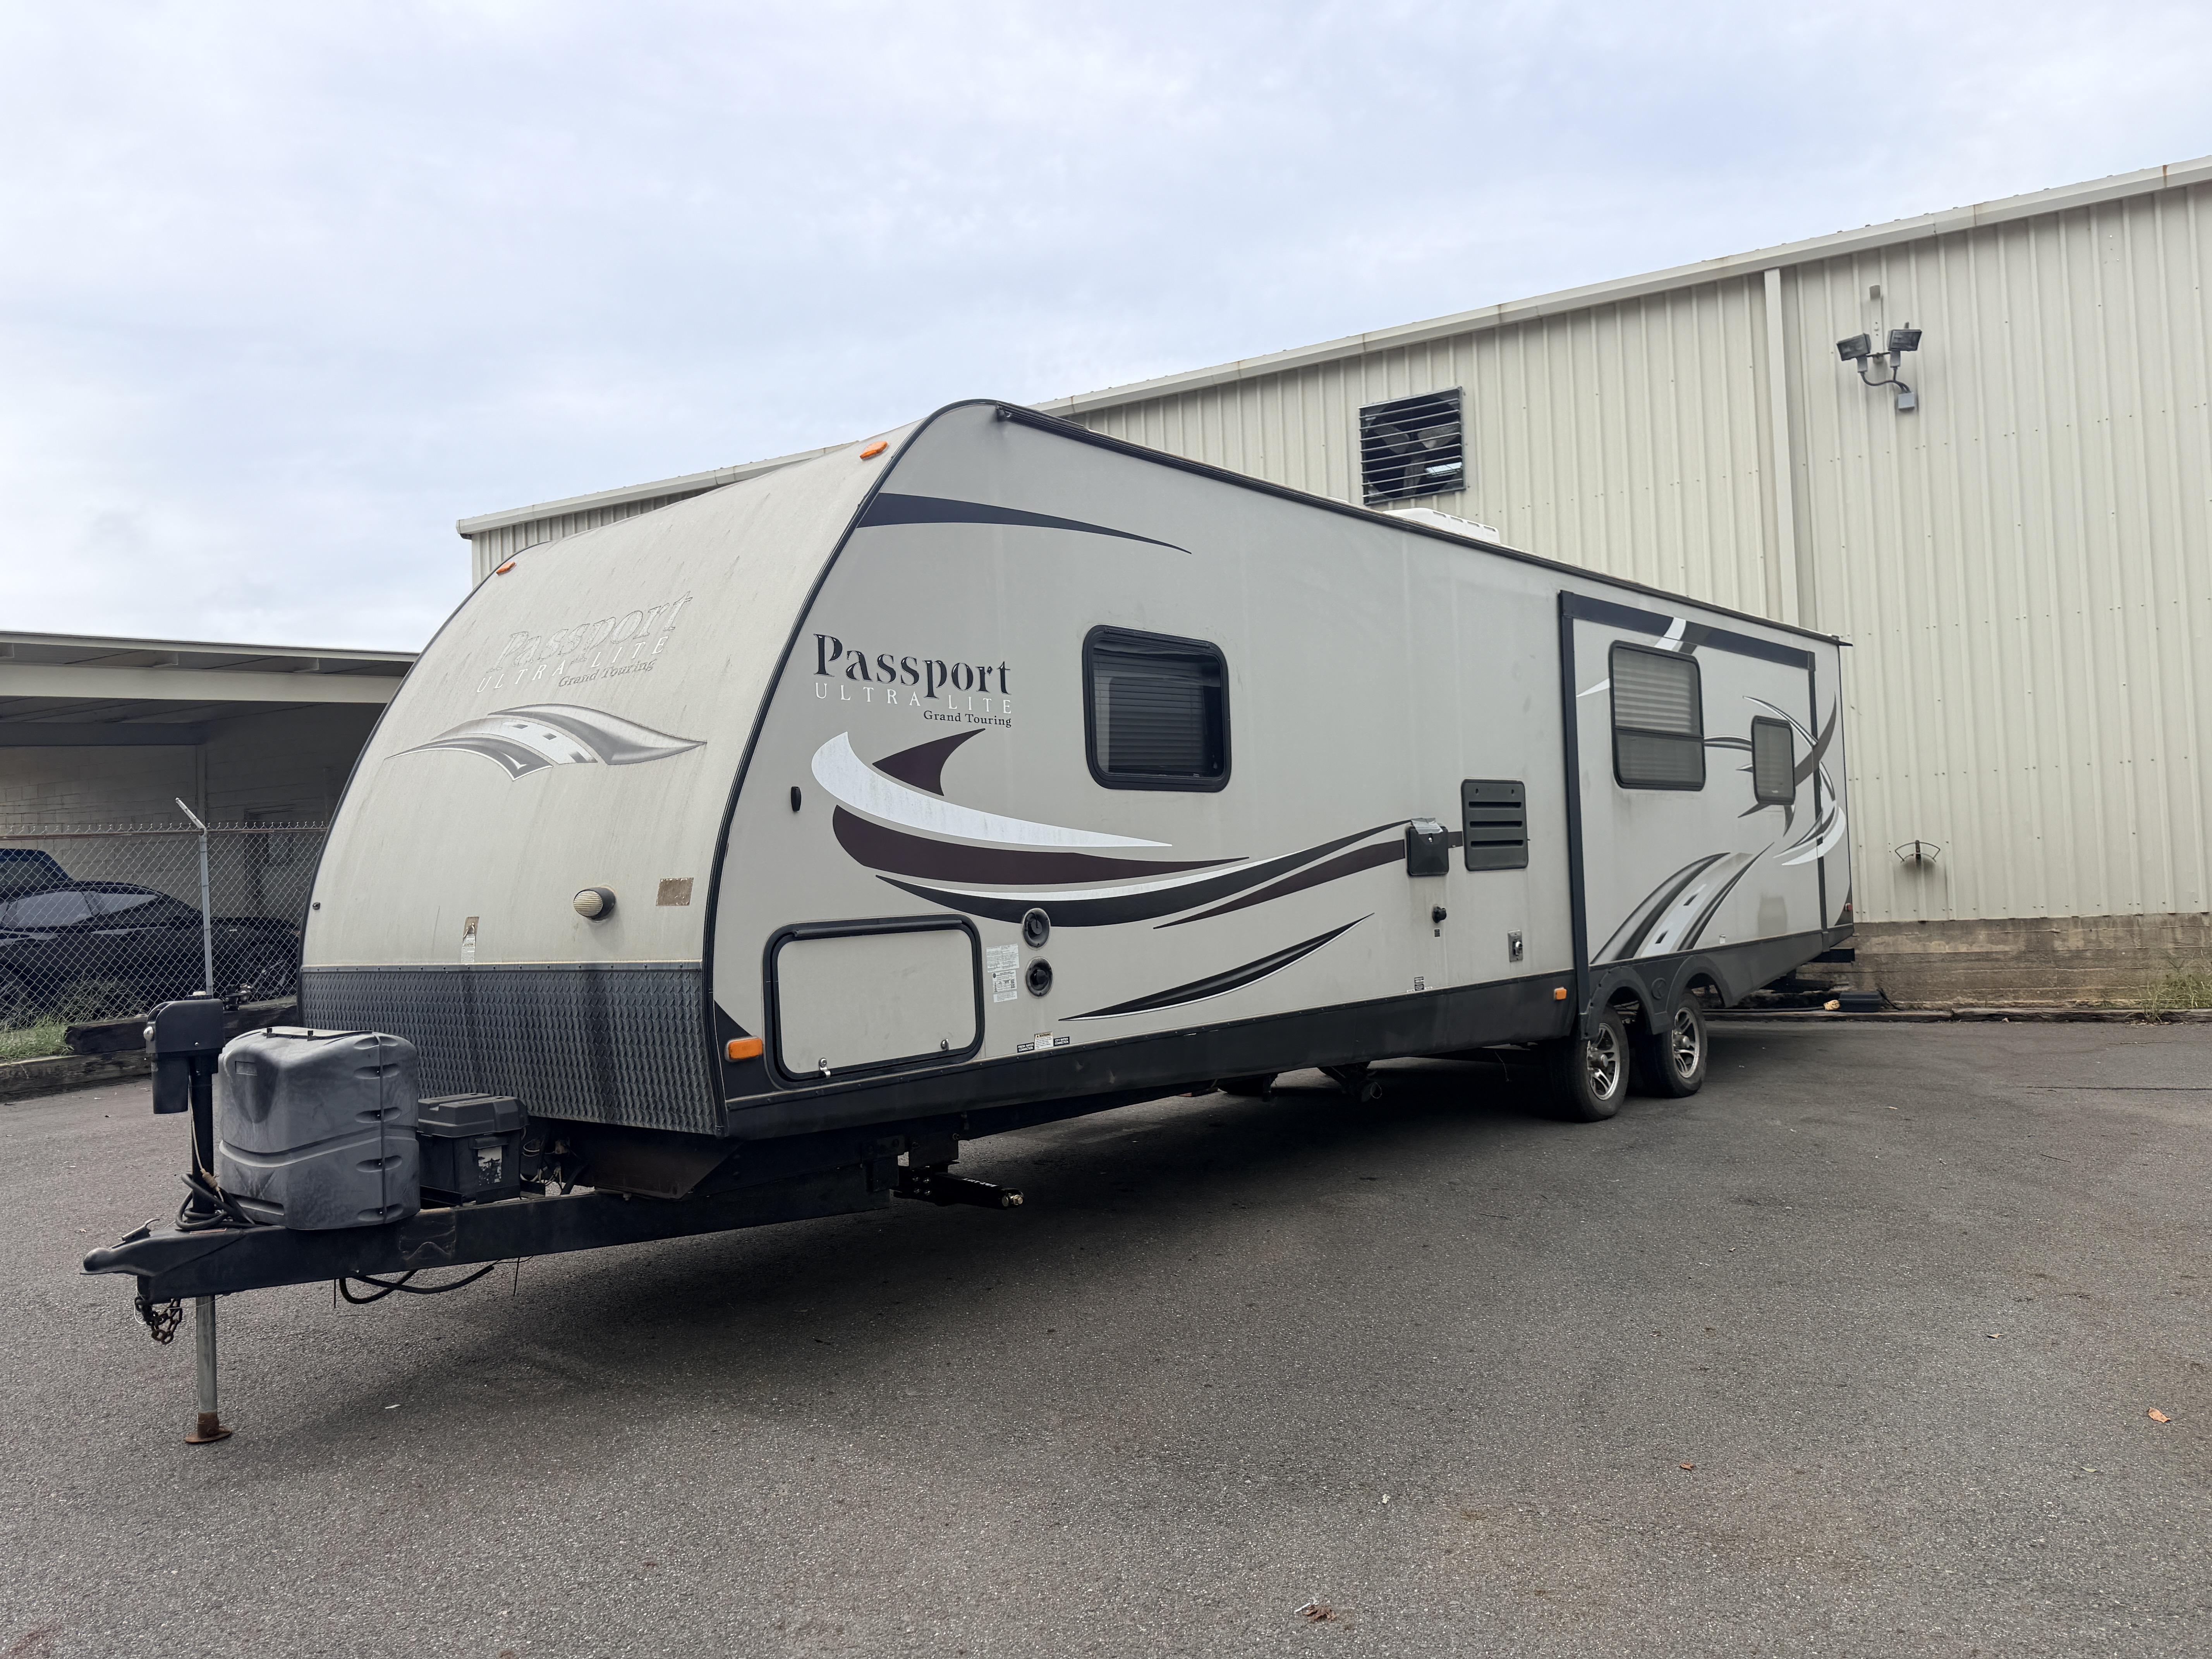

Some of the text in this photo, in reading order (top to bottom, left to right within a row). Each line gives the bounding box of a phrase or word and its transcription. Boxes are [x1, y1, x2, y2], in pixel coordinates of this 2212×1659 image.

[486, 590, 693, 673] Passport
[476, 635, 669, 693] ULTRA LITE
[558, 658, 658, 688] Grand Touring
[813, 633, 1012, 699] Passport
[815, 682, 1012, 714] ULTRA LITE
[923, 710, 1012, 728] Grand Touring
